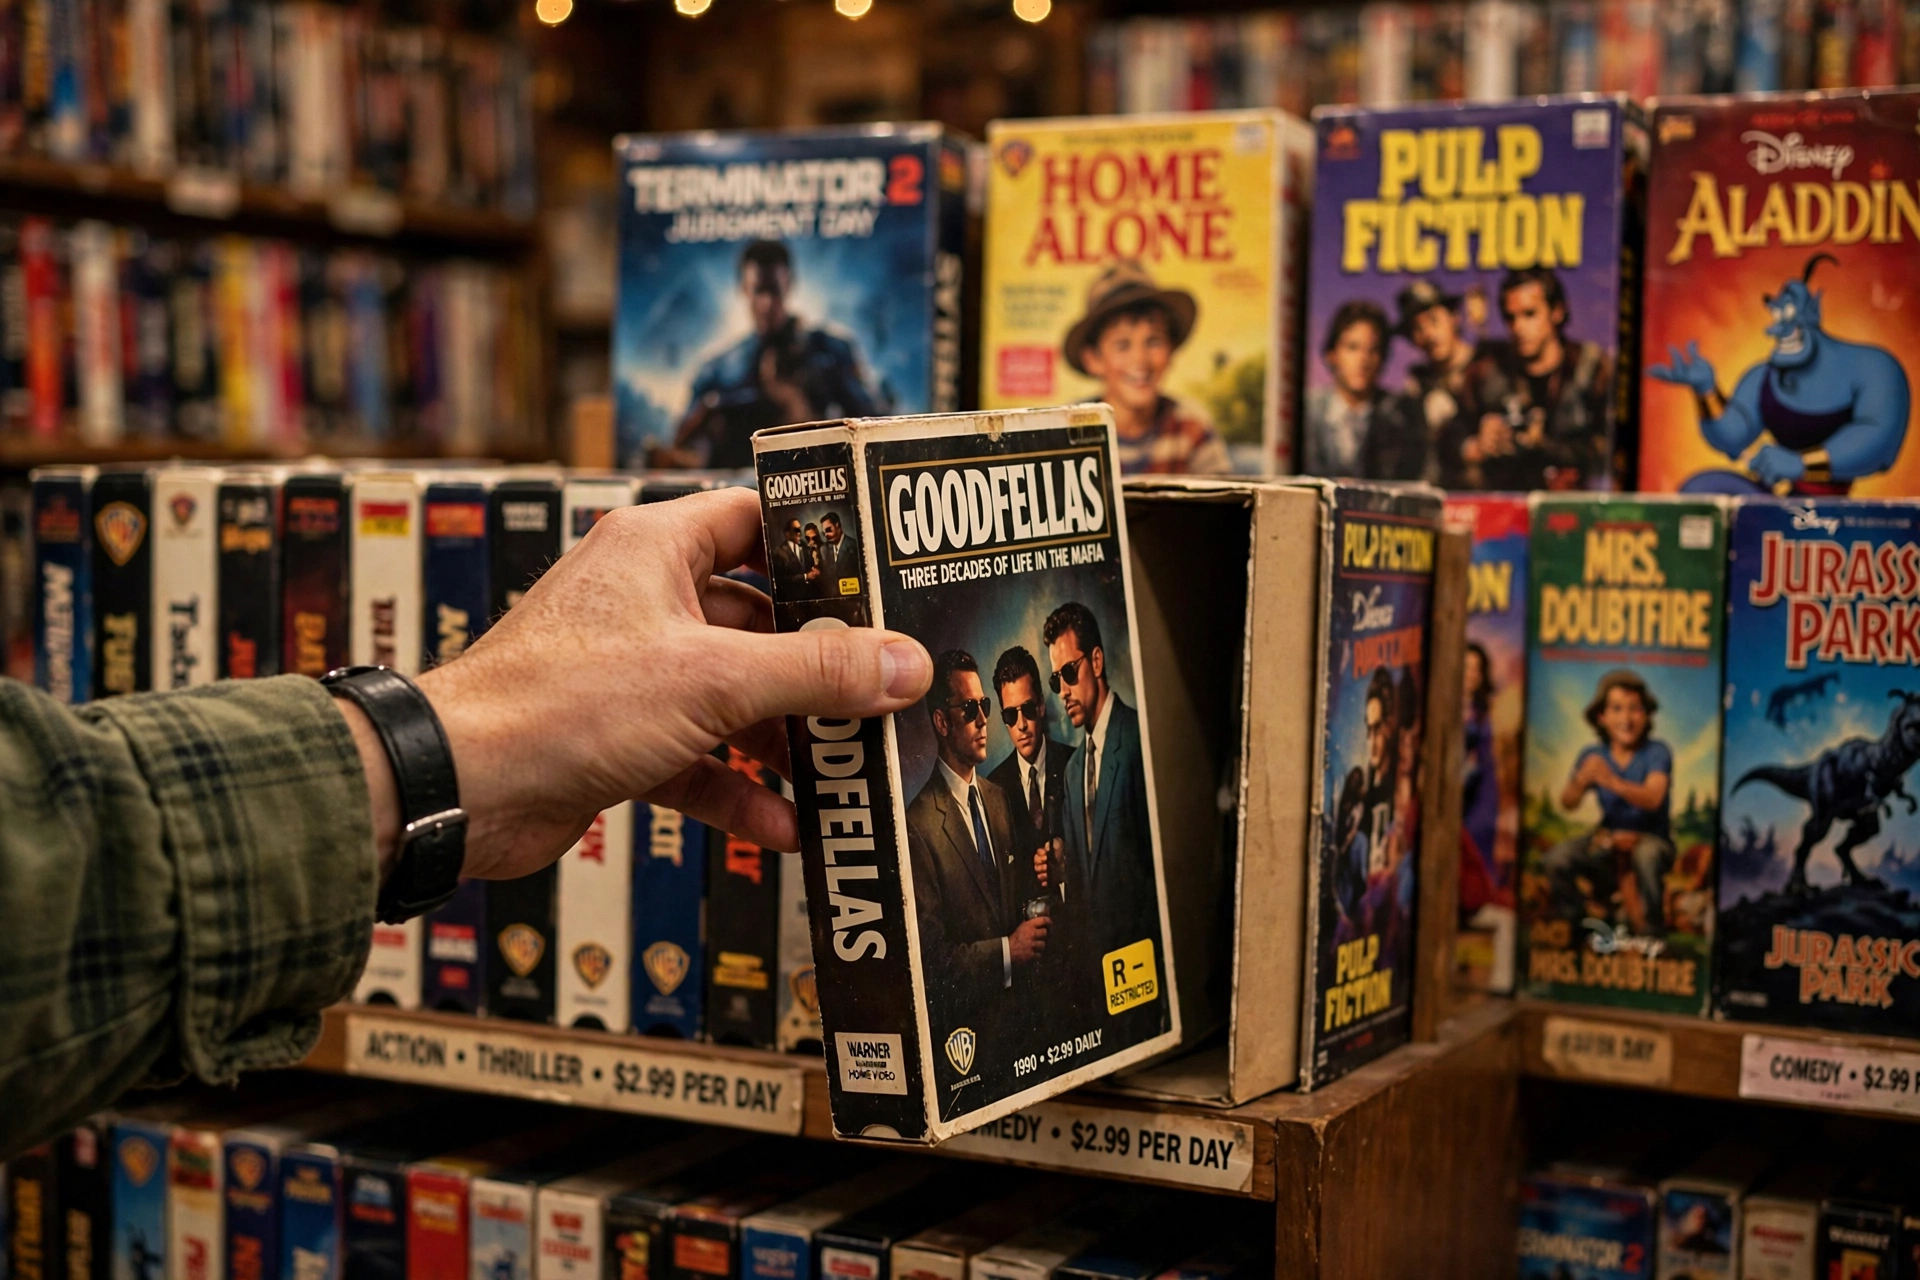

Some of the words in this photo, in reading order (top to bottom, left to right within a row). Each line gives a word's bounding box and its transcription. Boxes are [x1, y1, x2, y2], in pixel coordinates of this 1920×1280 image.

[628, 158, 885, 213] TERMINATOR
[887, 154, 923, 206] 2
[1042, 147, 1224, 206] HOME
[1379, 124, 1543, 199] PULP
[665, 210, 816, 243] JUDGMENT
[1025, 209, 1234, 267] ALONE
[1341, 193, 1585, 272] FICTION
[765, 467, 847, 499] GOODFELLAS
[889, 456, 1104, 555] GOODFELLAS
[899, 564, 938, 589] THREE
[941, 557, 992, 584] DECADES
[994, 554, 1009, 576] OF
[1011, 552, 1034, 574] LIFE
[1035, 550, 1048, 570] IN
[1048, 547, 1070, 567] THE
[1071, 543, 1105, 564] MAFIA
[1583, 527, 1665, 585] MRS.
[1540, 584, 1711, 648] DOUBTFIRE
[1785, 597, 1920, 669] PARK
[799, 617, 887, 962] ODFELLAS
[1112, 959, 1126, 987] R
[1336, 934, 1379, 984] PULP
[1799, 966, 1894, 1010] PARK
[1110, 980, 1155, 1008] RESTRICTED
[1324, 968, 1393, 1032] FICTION
[365, 1031, 446, 1068] ACTION
[477, 1043, 583, 1085] THRILLER
[613, 1061, 675, 1098] $2.99
[681, 1071, 727, 1105] PER
[735, 1078, 782, 1114] DAY
[847, 1041, 890, 1059] WARNER
[1013, 1054, 1037, 1077] 1990
[1047, 1040, 1073, 1065] $2.99
[1075, 1029, 1102, 1054] DAILY
[1770, 1054, 1843, 1085] COMEDY
[1863, 1064, 1910, 1092] $2.99
[969, 1114, 1042, 1142] MEDY
[1071, 1120, 1130, 1154] $2.99
[1138, 1129, 1181, 1163] PER
[1189, 1136, 1234, 1170] DAY
